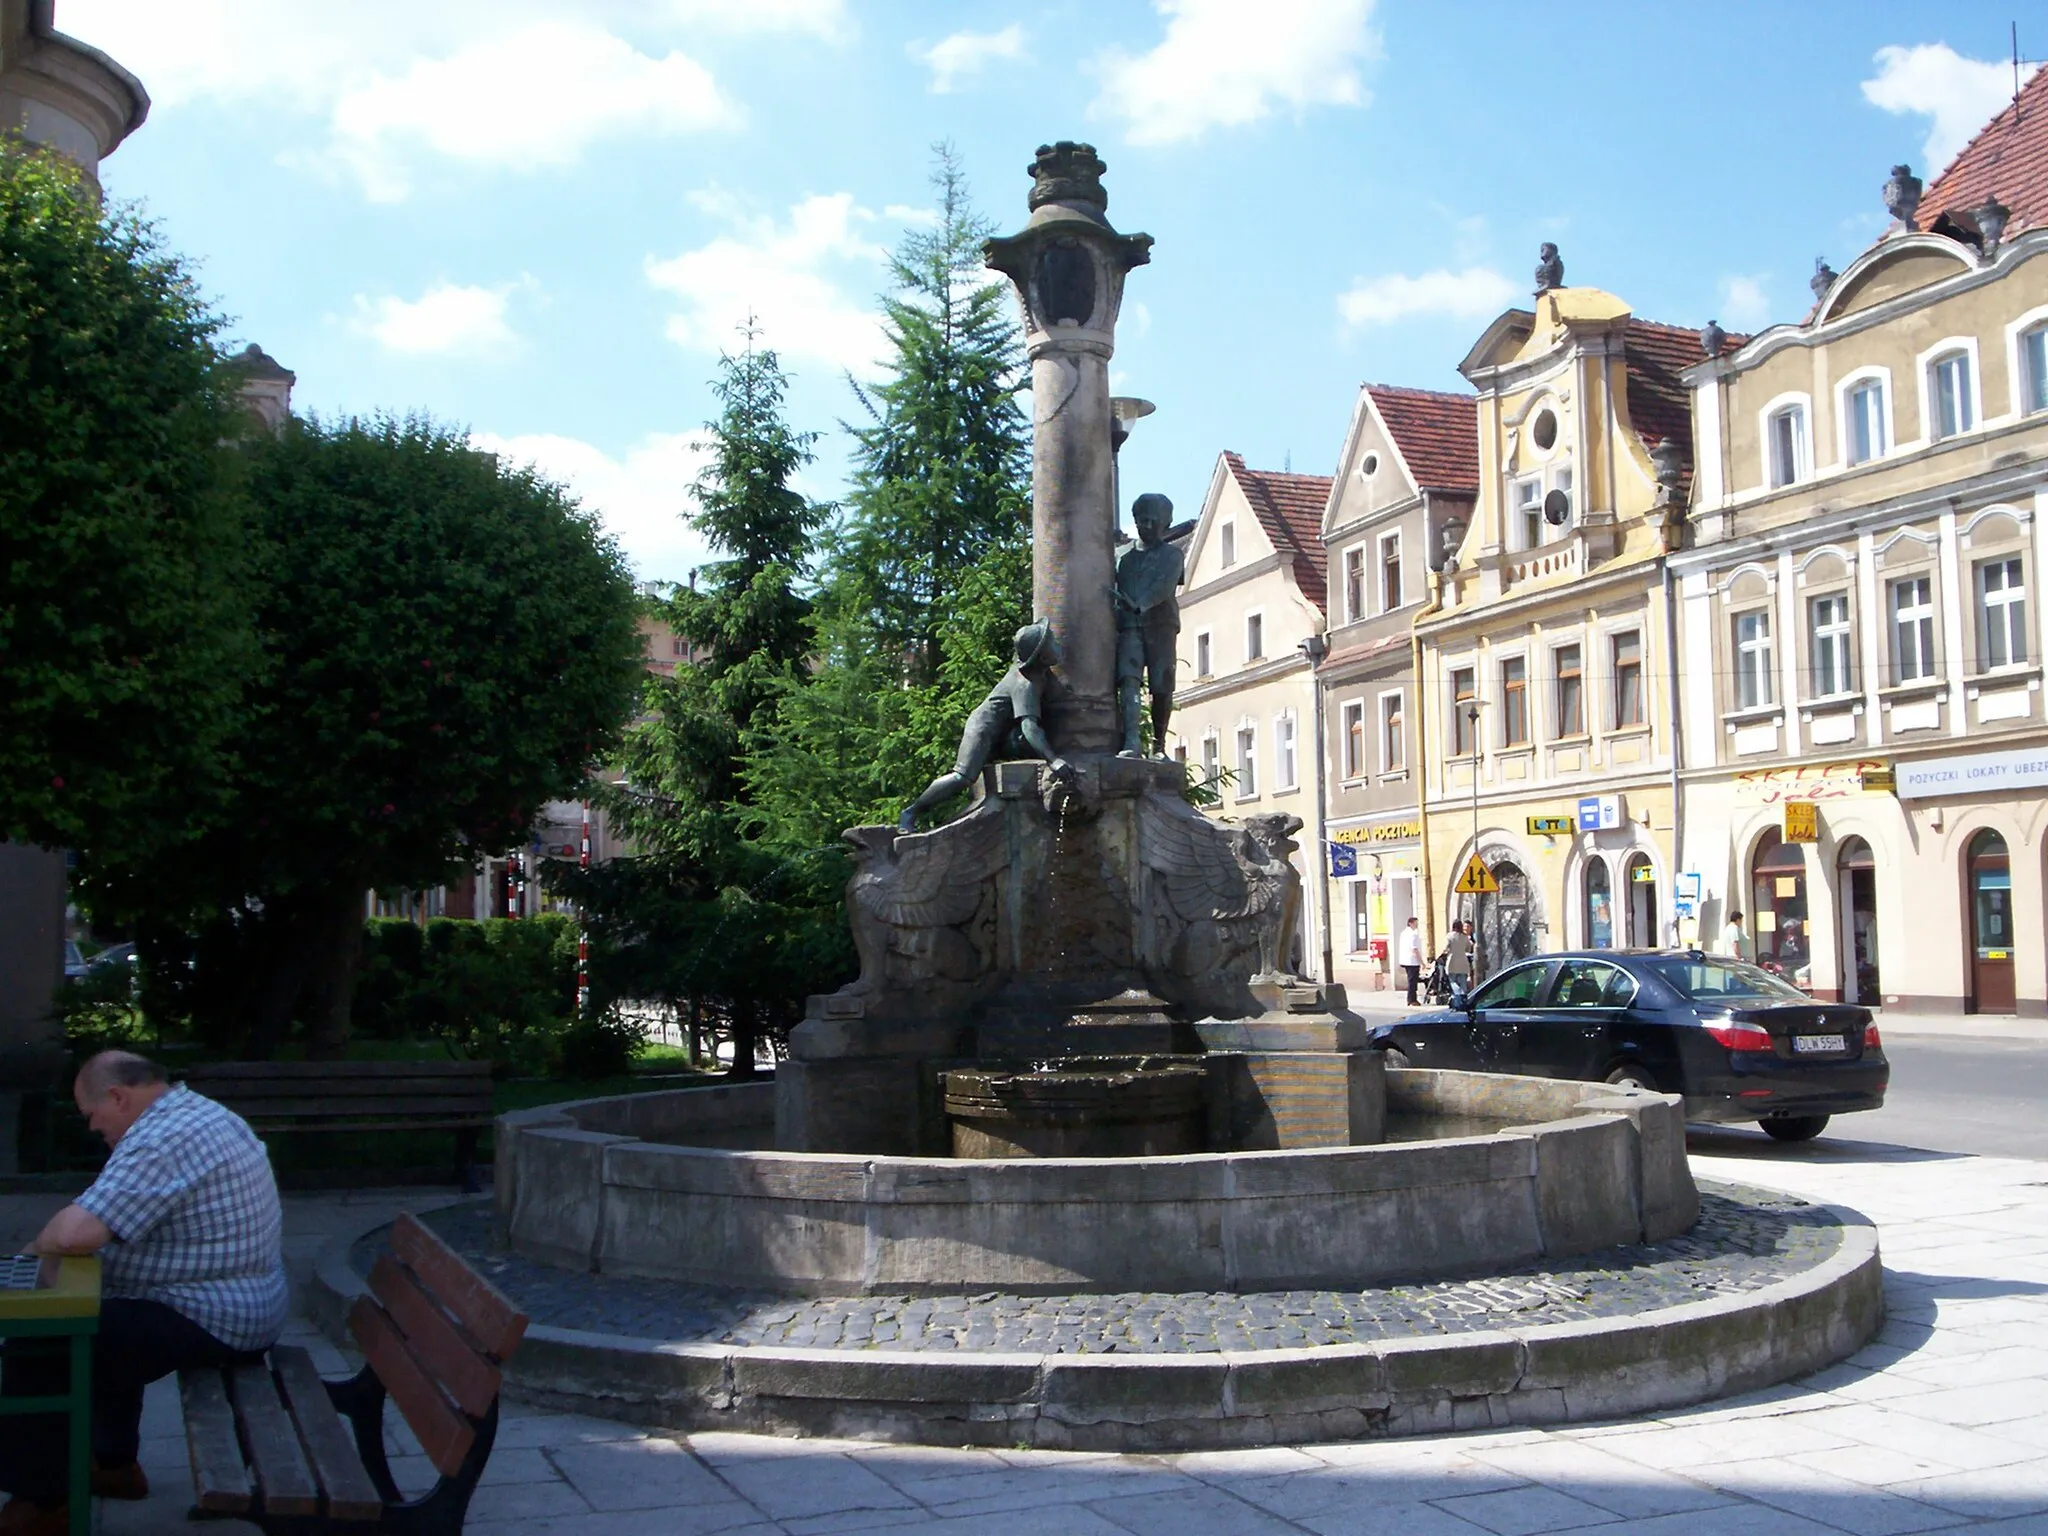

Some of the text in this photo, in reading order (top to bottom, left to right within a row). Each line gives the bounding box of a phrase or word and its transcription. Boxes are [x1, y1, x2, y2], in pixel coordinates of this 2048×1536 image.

[1738, 761, 1882, 786] SKLEP
[1967, 765, 2007, 779] LOKATY
[1373, 822, 1421, 840] POCZTOWA
[1534, 819, 1567, 830] LOTTO
